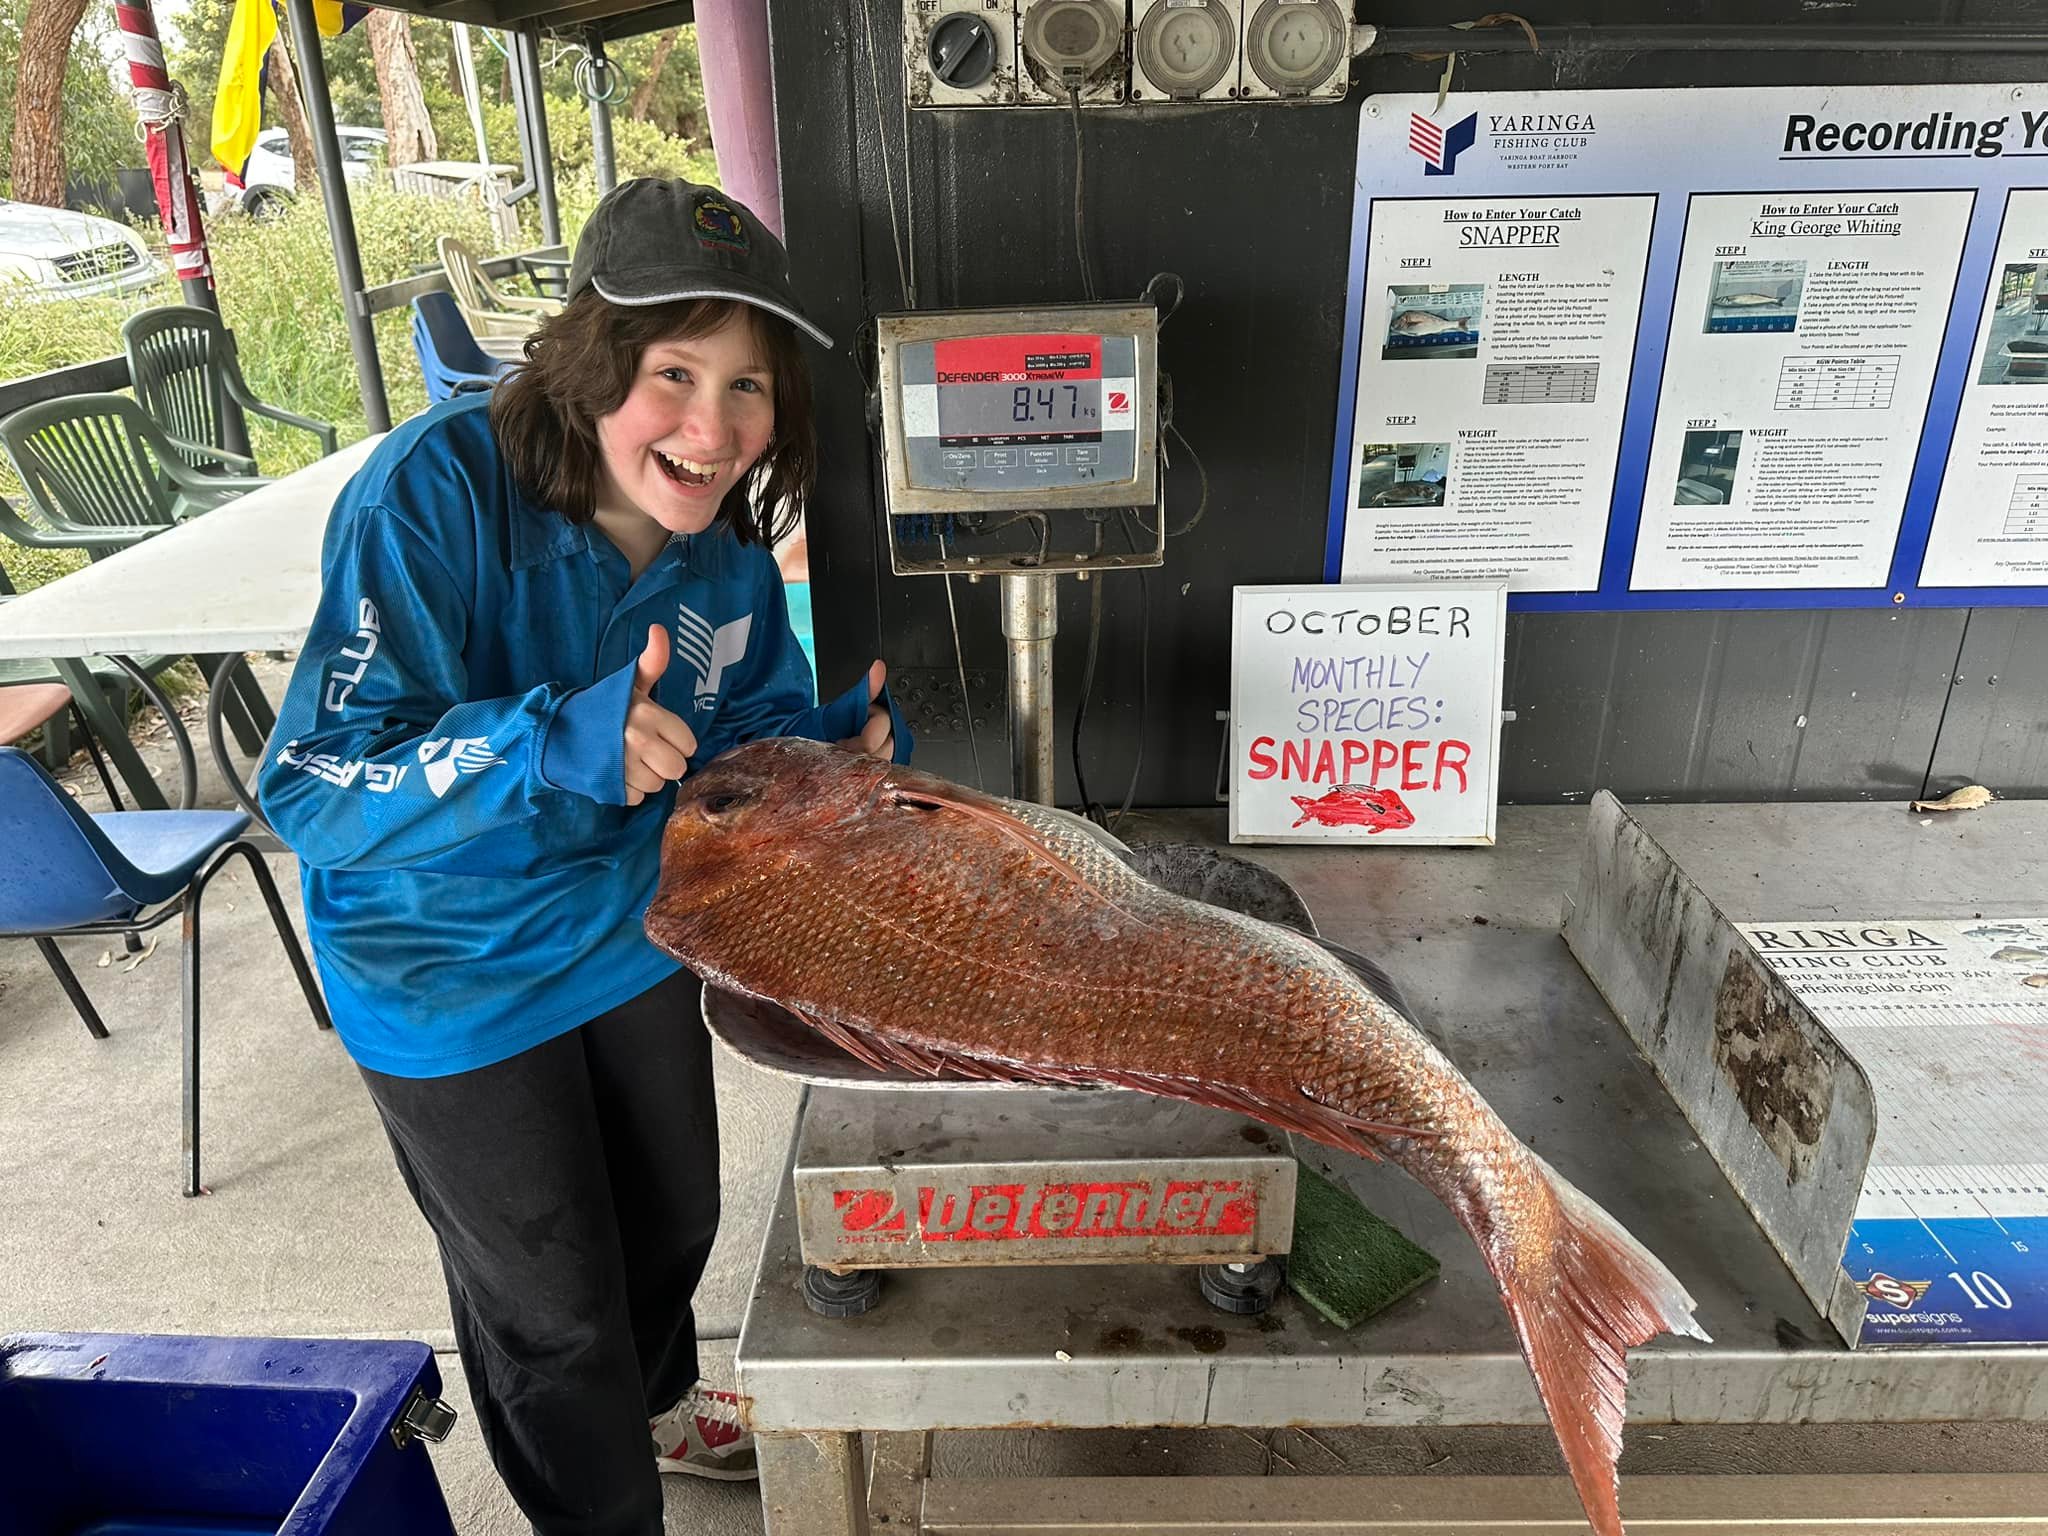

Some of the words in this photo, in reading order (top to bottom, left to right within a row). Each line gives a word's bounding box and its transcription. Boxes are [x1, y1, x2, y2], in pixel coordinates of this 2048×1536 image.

[921, 1, 937, 10] OFF
[986, 0, 998, 9] ON
[1489, 114, 1596, 131] YARINGA
[1783, 112, 2009, 158] Recording
[2021, 111, 2048, 148] Y
[1494, 138, 1549, 149] FISHING
[1554, 137, 1587, 147] CLUB
[1444, 210, 1469, 220] How
[1472, 211, 1482, 219] to
[1485, 209, 1516, 219] Enter
[1520, 209, 1547, 219] Your
[1550, 208, 1582, 218] Catch
[1761, 205, 1787, 215] How
[1790, 206, 1800, 214] to
[1803, 204, 1834, 214] Enter
[1837, 203, 1865, 213] Your
[1867, 203, 1899, 213] Catch
[1460, 225, 1560, 245] SNAPPER
[1752, 221, 1787, 238] King
[1790, 220, 1841, 237] George
[1847, 219, 1902, 236] Whiting
[1715, 246, 1739, 255] STEP
[1742, 246, 1747, 254] 1
[1400, 258, 1425, 266] STEP
[1427, 258, 1432, 266] 1
[1828, 262, 1869, 270] LENGTH
[1499, 273, 1540, 282] LENGTH
[937, 372, 999, 383] DEFENDER
[1013, 385, 1077, 422] 8.47
[1084, 407, 1096, 417] kg
[1386, 416, 1410, 424] STEP
[1412, 416, 1416, 424] 2
[1686, 420, 1709, 428] STEP
[1458, 430, 1498, 438] WEIGHT
[1266, 606, 1470, 638] OCTOBER
[325, 598, 381, 712] CLUB
[1291, 652, 1430, 694] MONTHLY
[1297, 696, 1444, 733] SPECIES:
[1248, 736, 1471, 793] SNAPPER
[1749, 928, 1944, 949] RINGA
[1769, 956, 1851, 969] HING
[1862, 954, 1948, 967] CLUB
[1782, 973, 1826, 981] BOUR
[1829, 971, 1908, 980] WESTERN
[1914, 971, 1956, 979] PORT
[1962, 970, 1994, 978] BAY
[1792, 982, 1952, 995] afishingclub.com
[923, 1183, 1252, 1237] Defender
[1862, 1242, 1874, 1254] 5
[1948, 1270, 2013, 1309] 10
[2011, 1241, 2029, 1253] 15
[1866, 1311, 1963, 1326] supersigns
